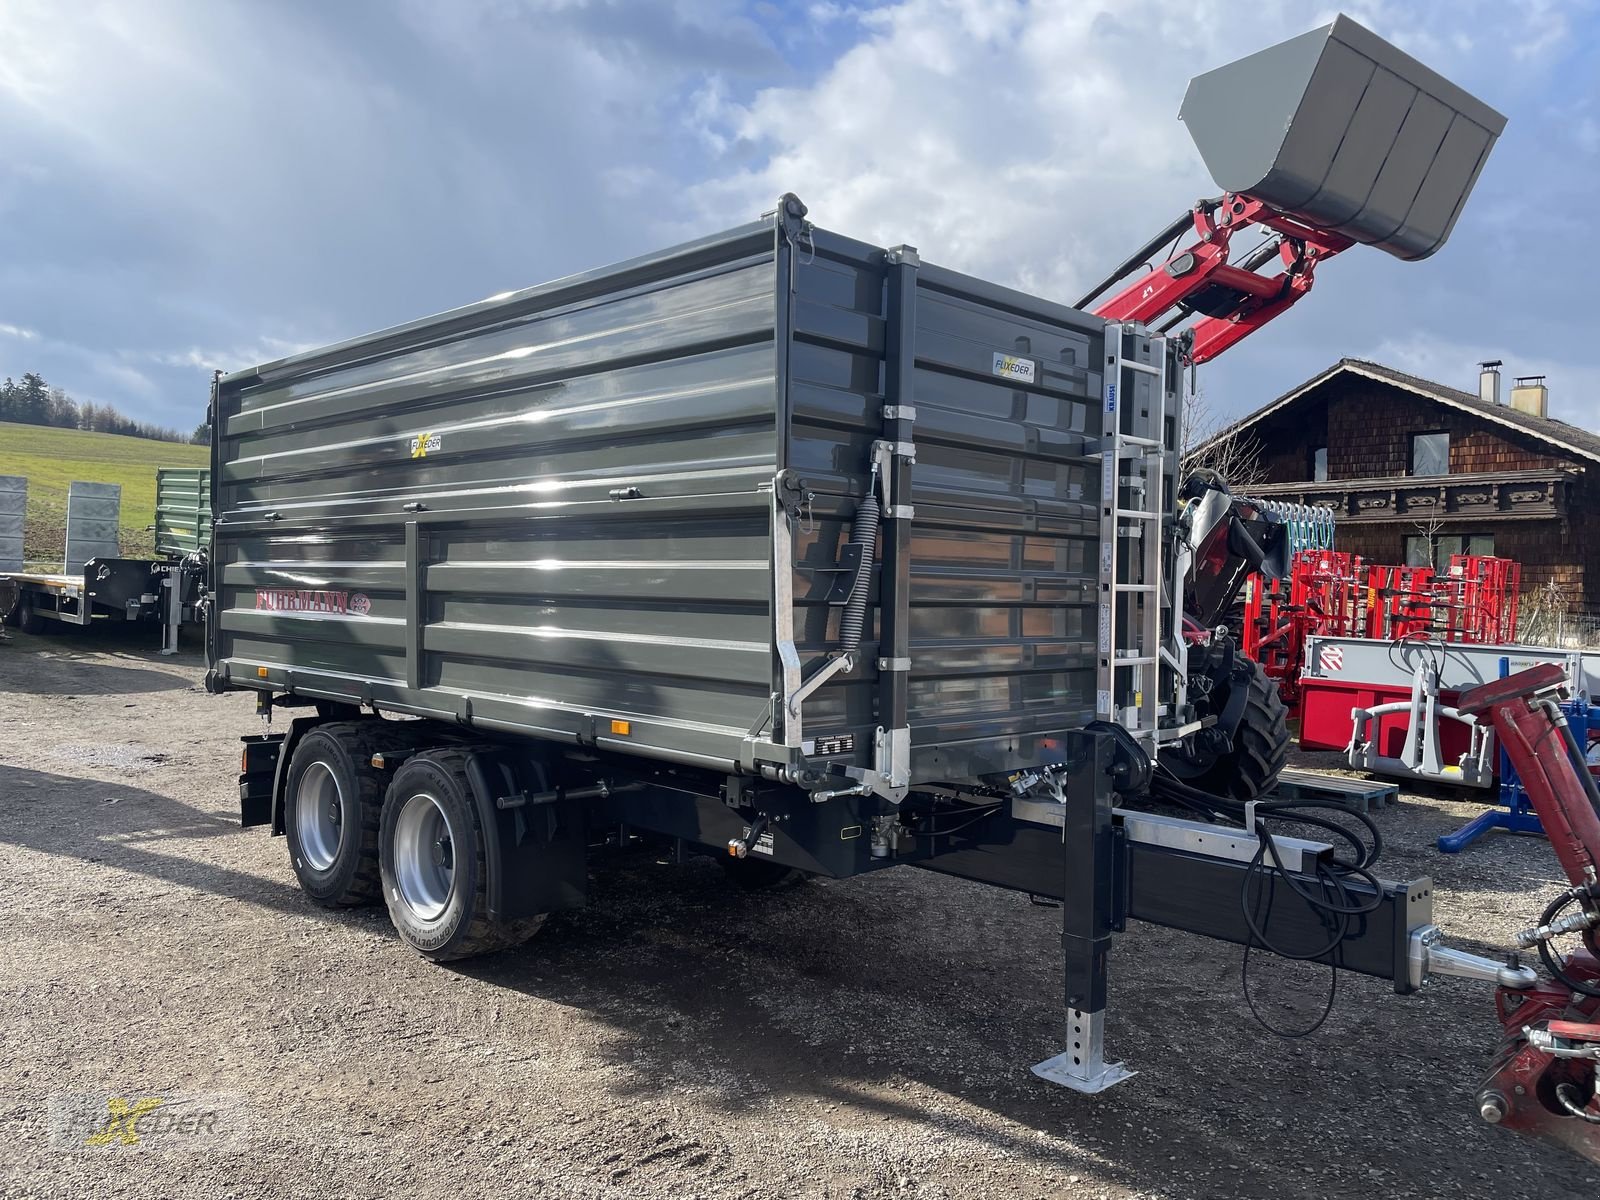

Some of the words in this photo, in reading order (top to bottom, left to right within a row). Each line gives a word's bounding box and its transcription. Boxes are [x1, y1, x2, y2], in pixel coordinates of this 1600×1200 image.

[995, 359, 1030, 375] FLIXEDER
[1108, 384, 1116, 412] KRAUSE
[161, 565, 181, 573] CHIE
[255, 589, 348, 615] FUHRMANN
[1368, 587, 1376, 608] TAIFUN
